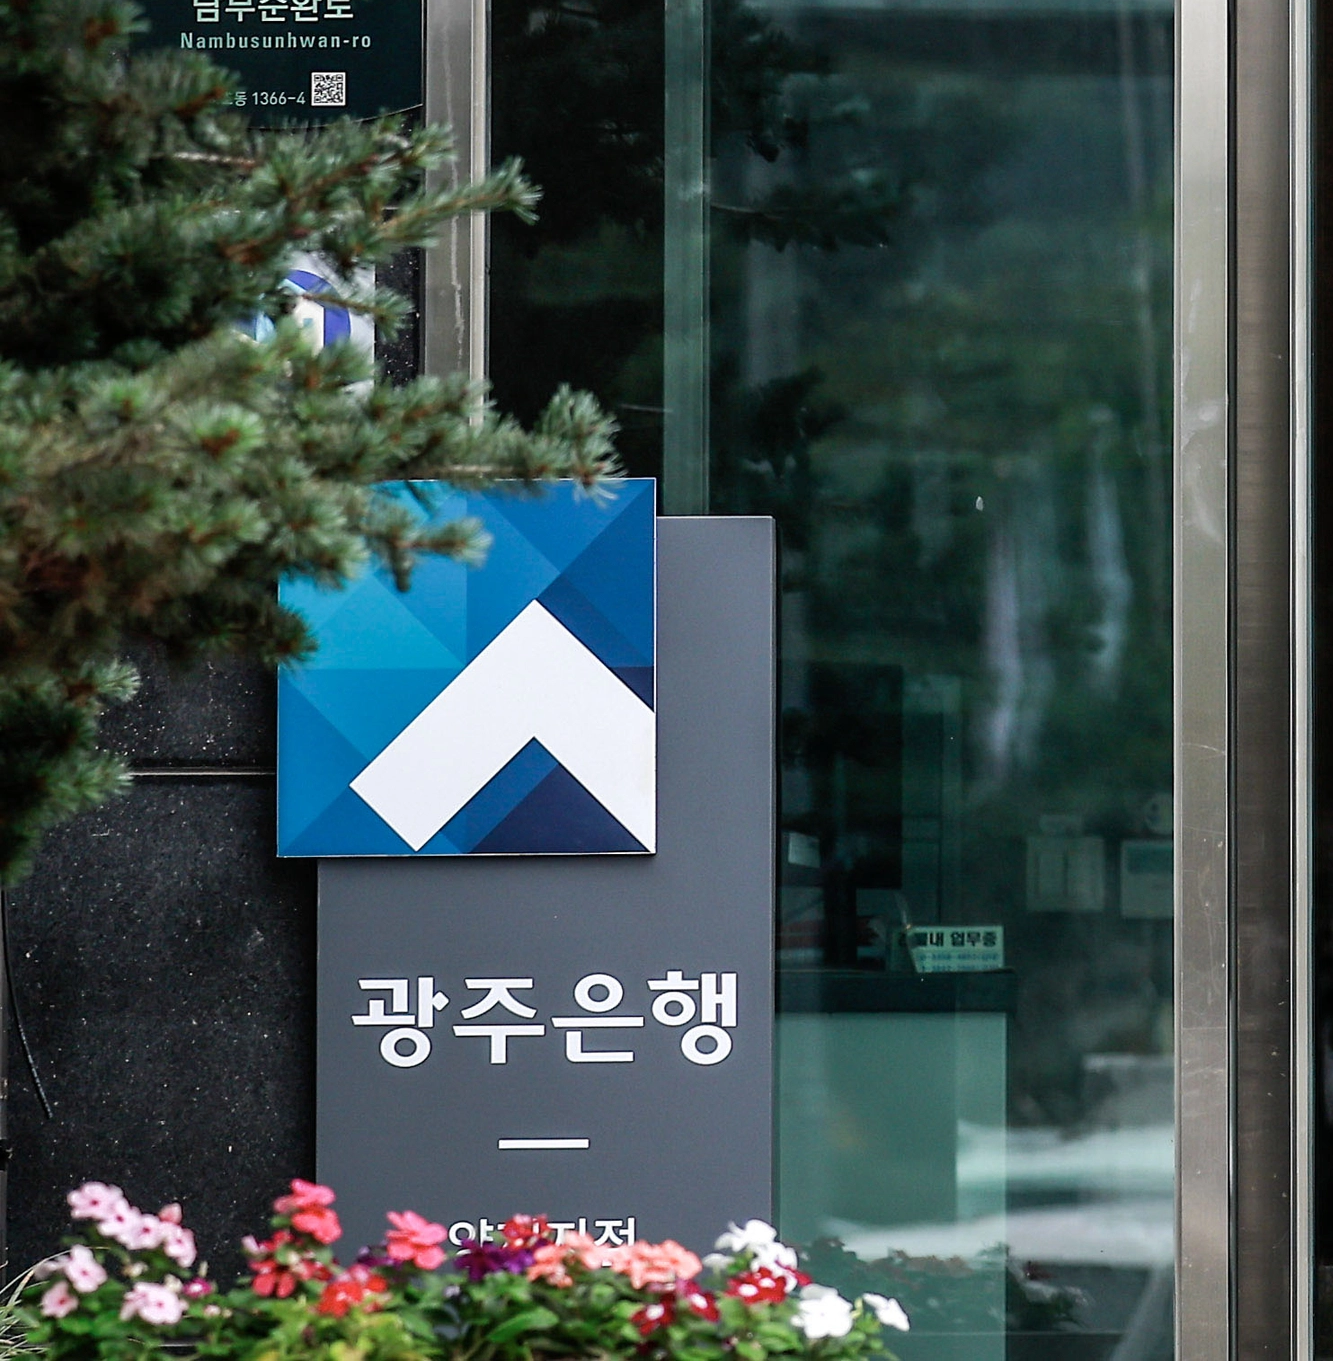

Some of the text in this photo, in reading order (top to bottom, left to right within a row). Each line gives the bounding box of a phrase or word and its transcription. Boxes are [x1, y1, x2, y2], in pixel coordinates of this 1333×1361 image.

[180, 32, 371, 49] Nambusunhwan-ro
[251, 91, 306, 105] 1366-4
[351, 970, 738, 1068] 광주은행
[448, 1217, 636, 1267] 양지점
